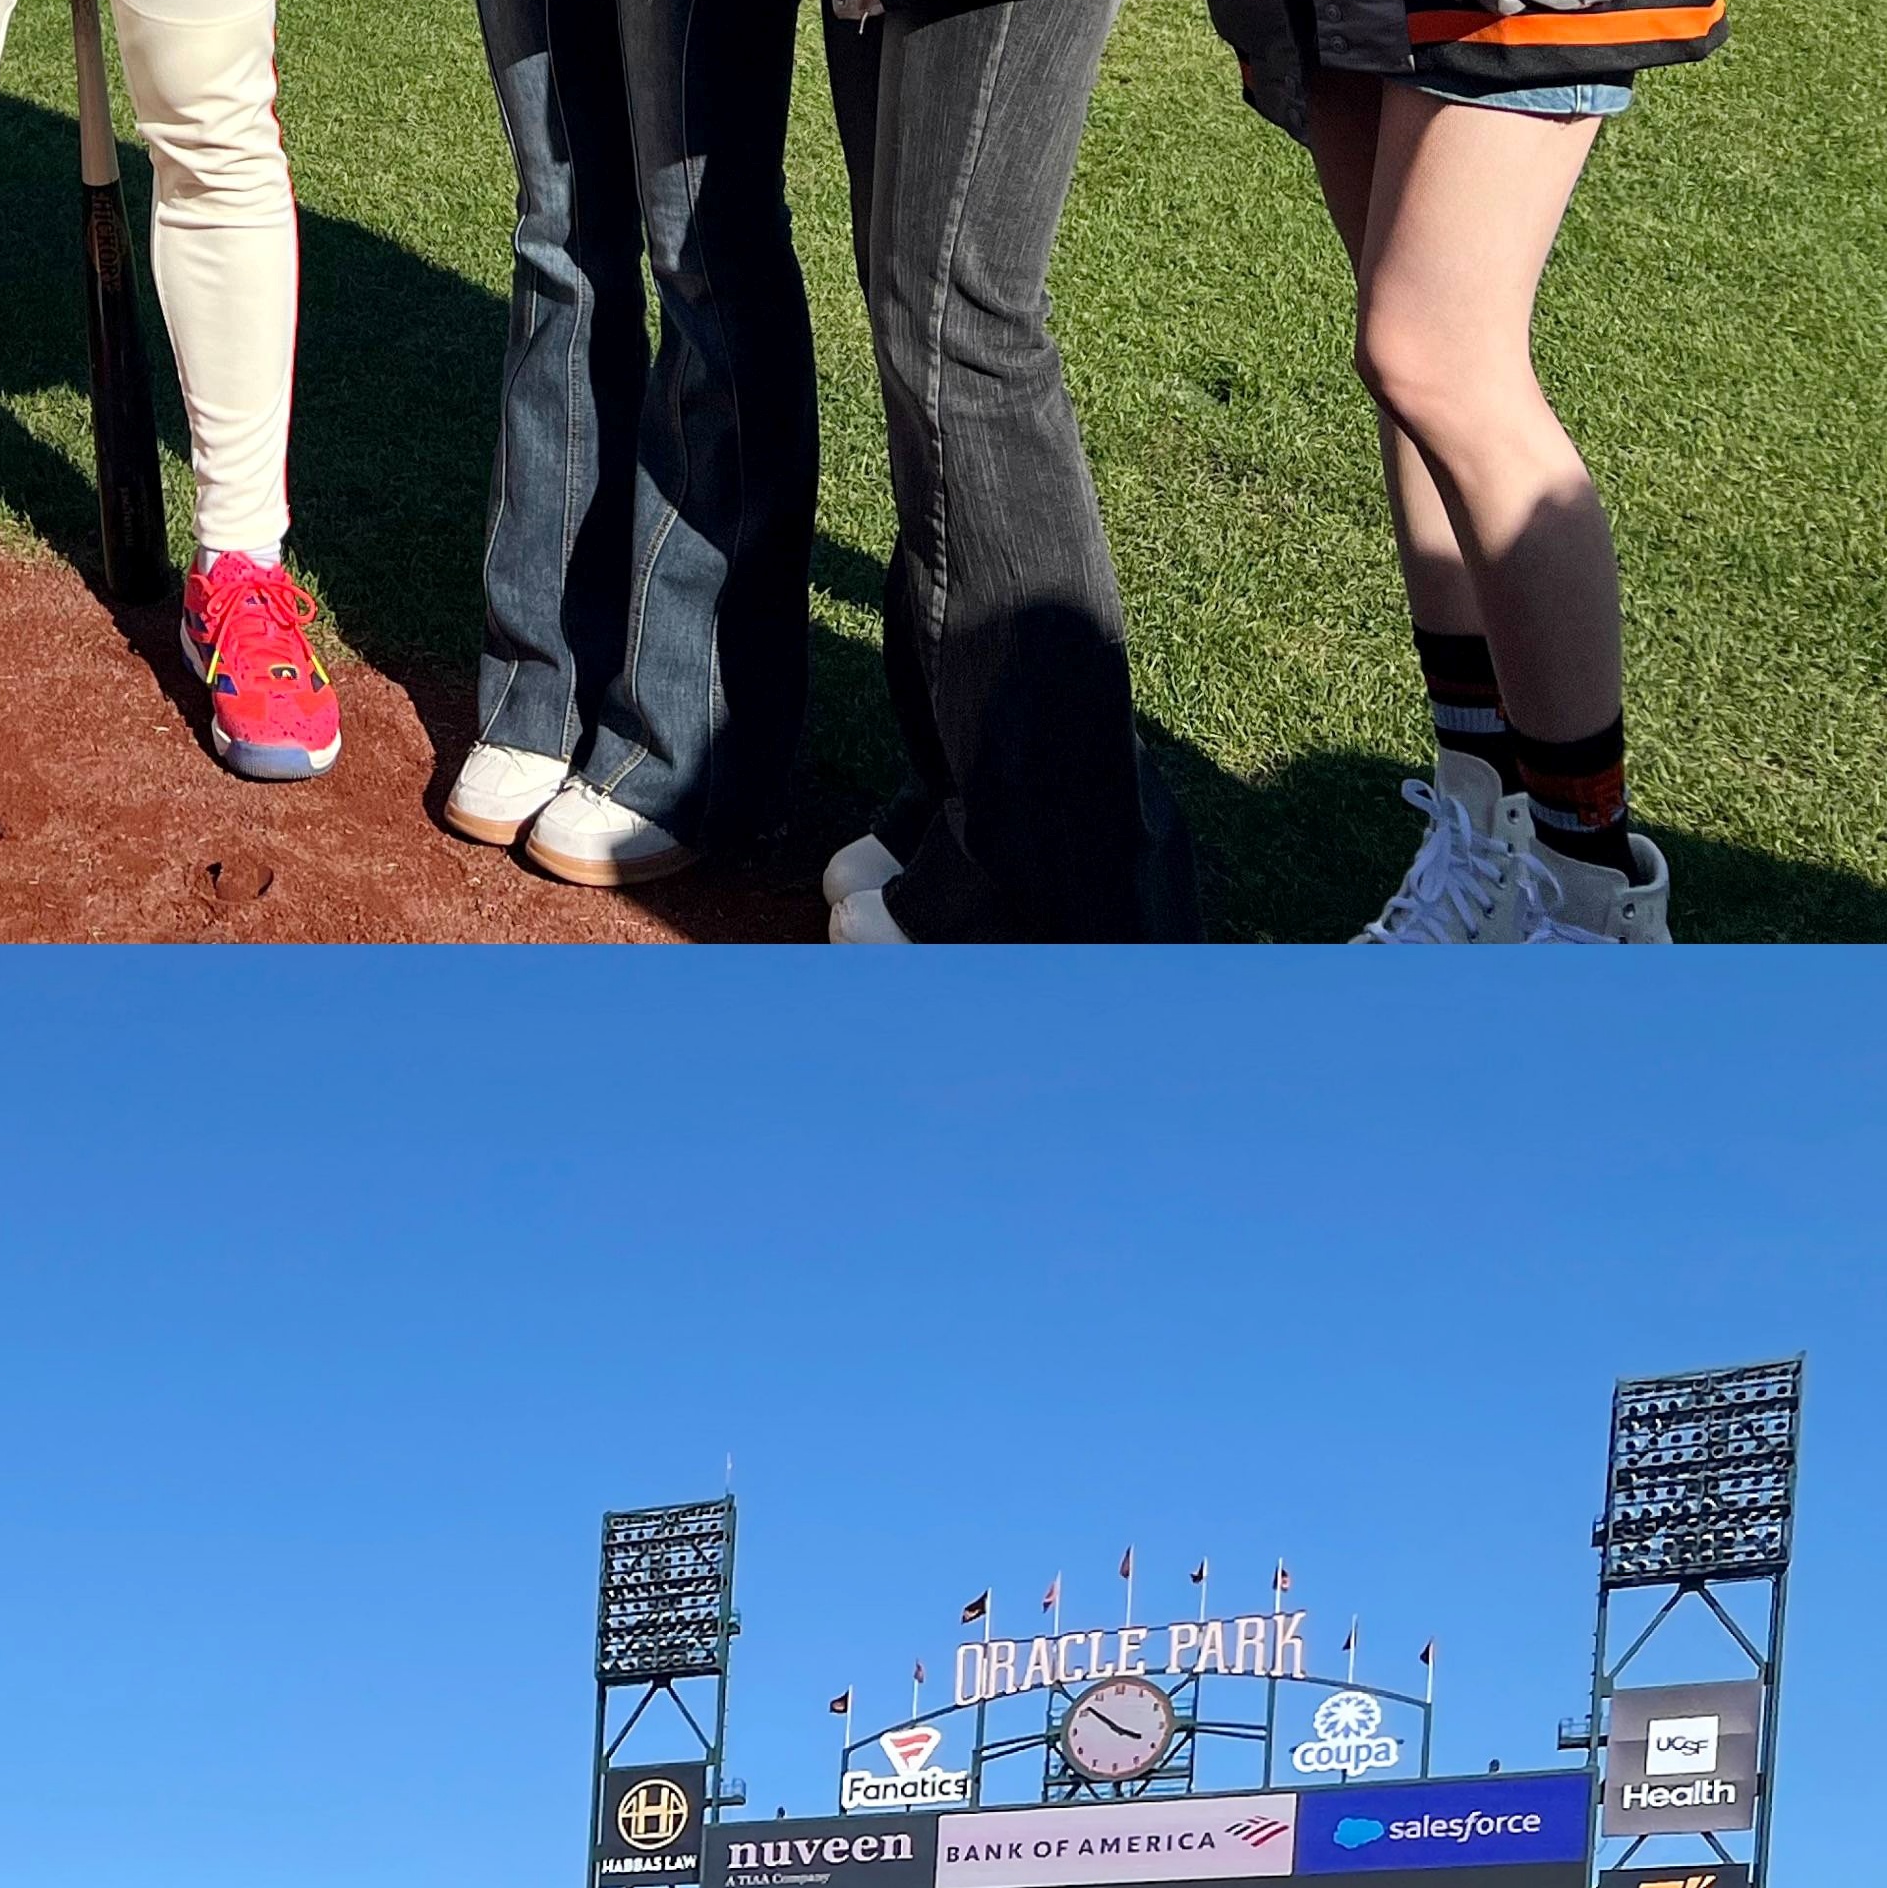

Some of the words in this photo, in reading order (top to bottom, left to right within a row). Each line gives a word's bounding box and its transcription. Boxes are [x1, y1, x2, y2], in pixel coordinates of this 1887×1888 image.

[954, 1625, 1146, 1707] ORACLE
[1166, 1610, 1307, 1679] PARK
[1298, 1740, 1392, 1775] coupa
[1656, 1736, 1709, 1755] UCSF
[848, 1773, 967, 1803] Fanatics
[1622, 1779, 1736, 1809] Health
[1388, 1811, 1540, 1844] salesforce
[727, 1832, 913, 1870] nuveen
[946, 1842, 1023, 1863] BANK
[1033, 1839, 1069, 1859] OF
[1078, 1832, 1216, 1856] AMERICA
[601, 1856, 662, 1874] HABBAS
[664, 1854, 698, 1871] LAW
[724, 1876, 735, 1887] A
[771, 1871, 831, 1886] Company
